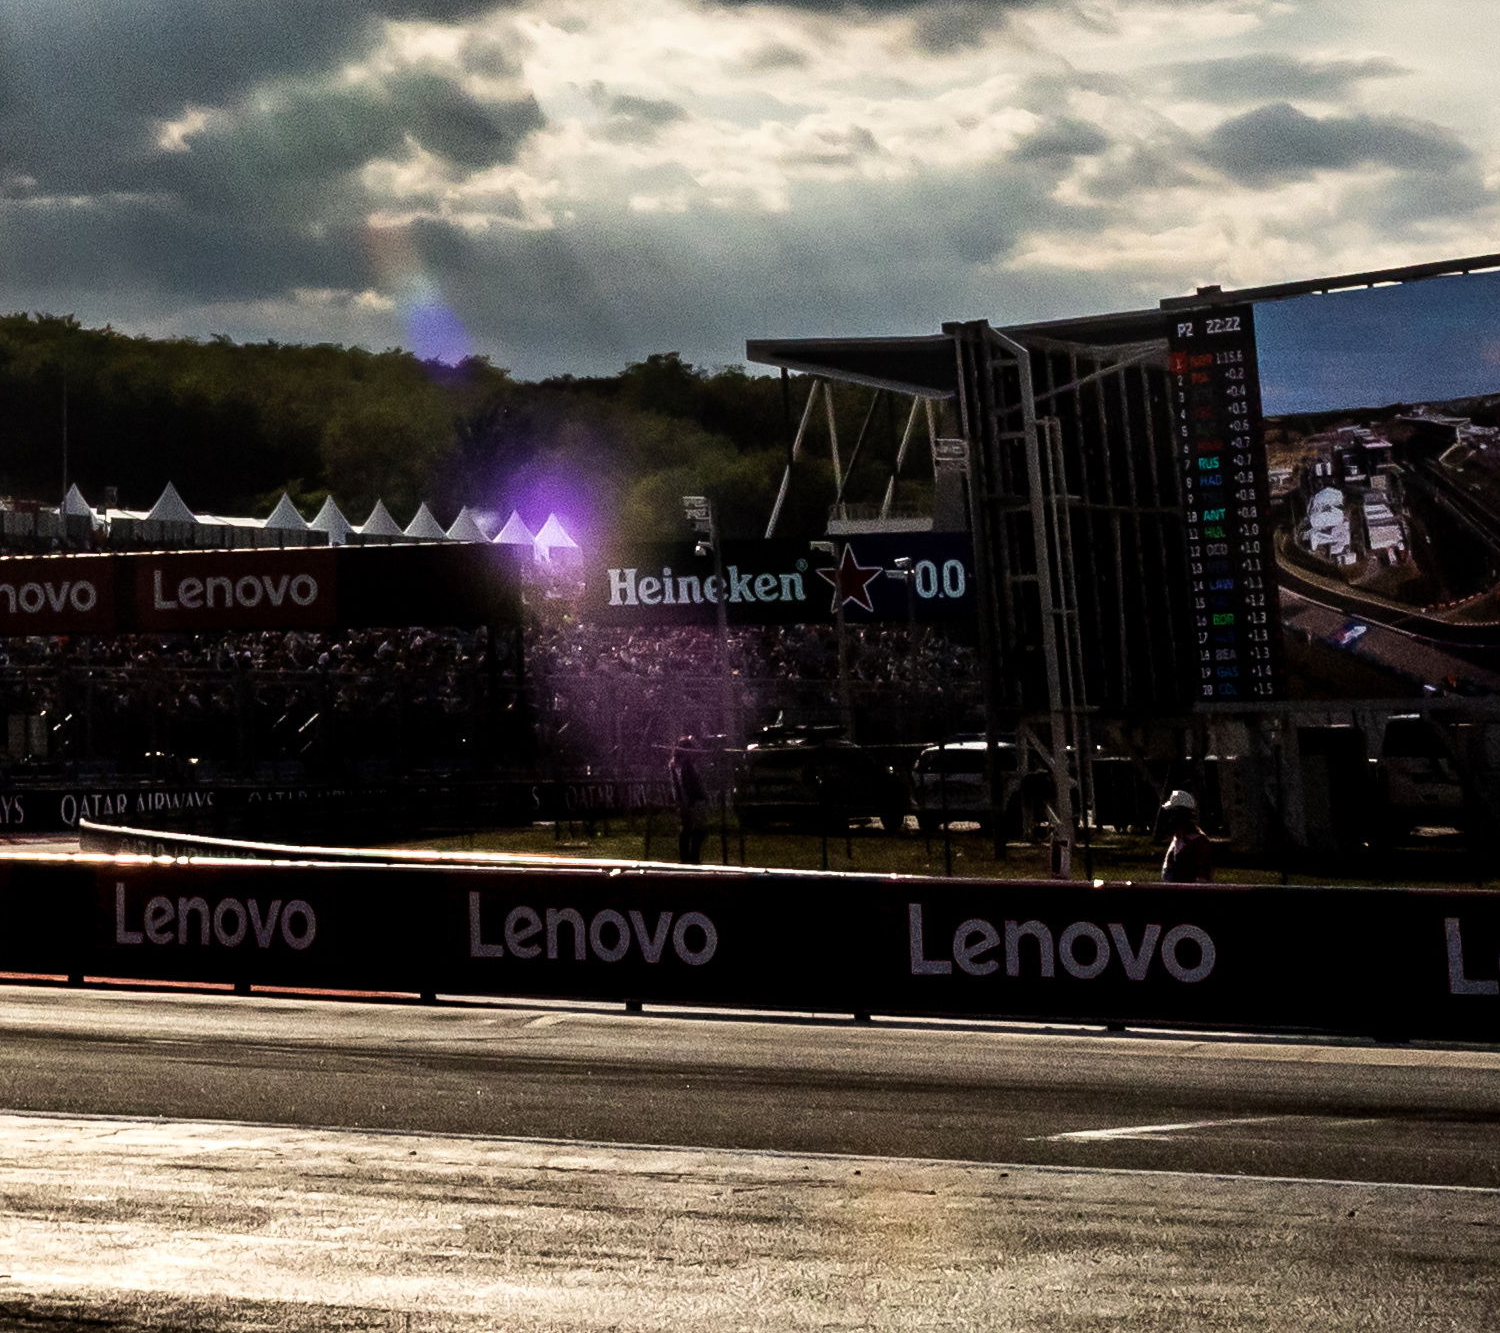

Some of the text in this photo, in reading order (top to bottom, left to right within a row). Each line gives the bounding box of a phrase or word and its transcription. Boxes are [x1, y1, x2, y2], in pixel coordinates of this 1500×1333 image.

[1177, 316, 1241, 337] P2 22:22
[1198, 456, 1220, 469] RUS
[152, 570, 318, 610] Lenovo
[915, 559, 966, 599] 0.0
[61, 794, 127, 826] QATAR
[115, 882, 317, 950] Lenovo
[469, 891, 718, 966] Lenovo
[908, 903, 1217, 983] Lenovo
